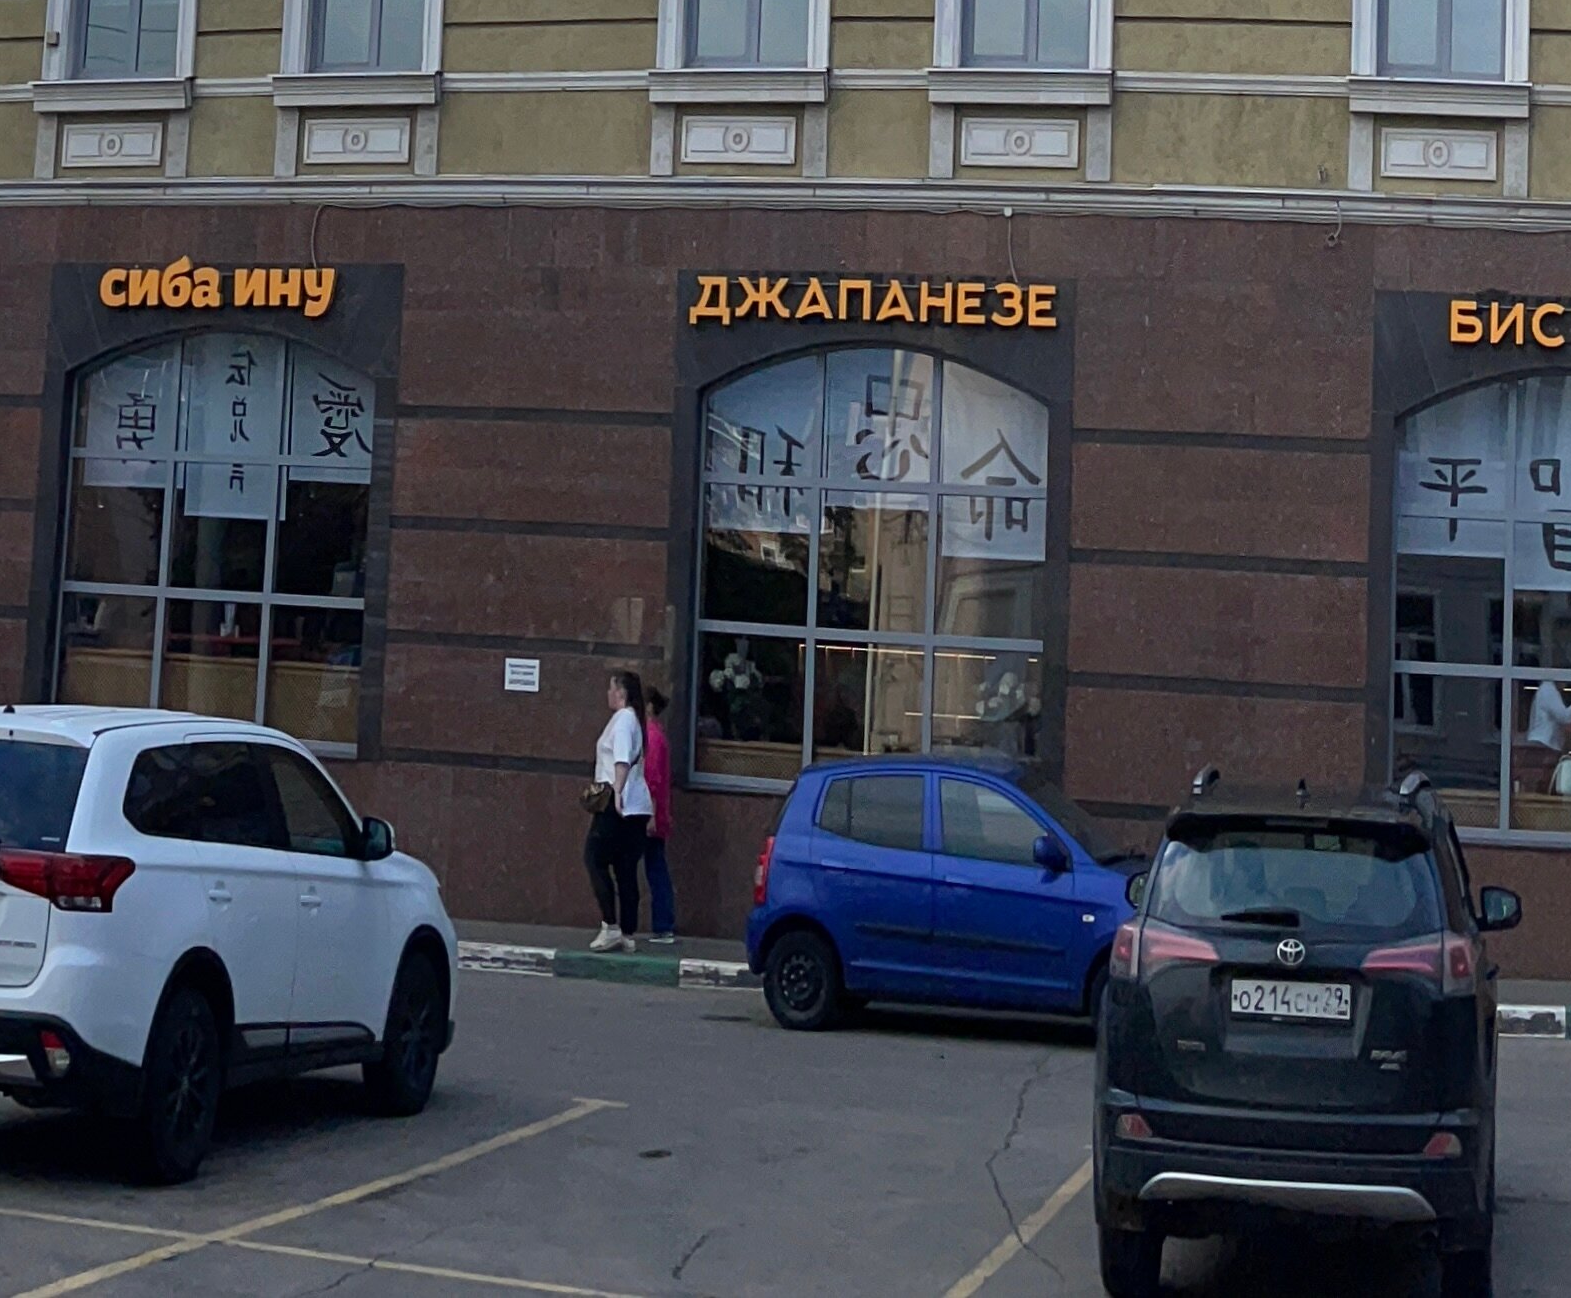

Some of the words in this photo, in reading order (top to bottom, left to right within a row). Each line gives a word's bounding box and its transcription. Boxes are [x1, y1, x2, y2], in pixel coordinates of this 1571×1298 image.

[100, 255, 221, 308] сиба
[234, 268, 336, 317] ину
[689, 275, 1058, 328] ДЖАПАНЕЗЕ
